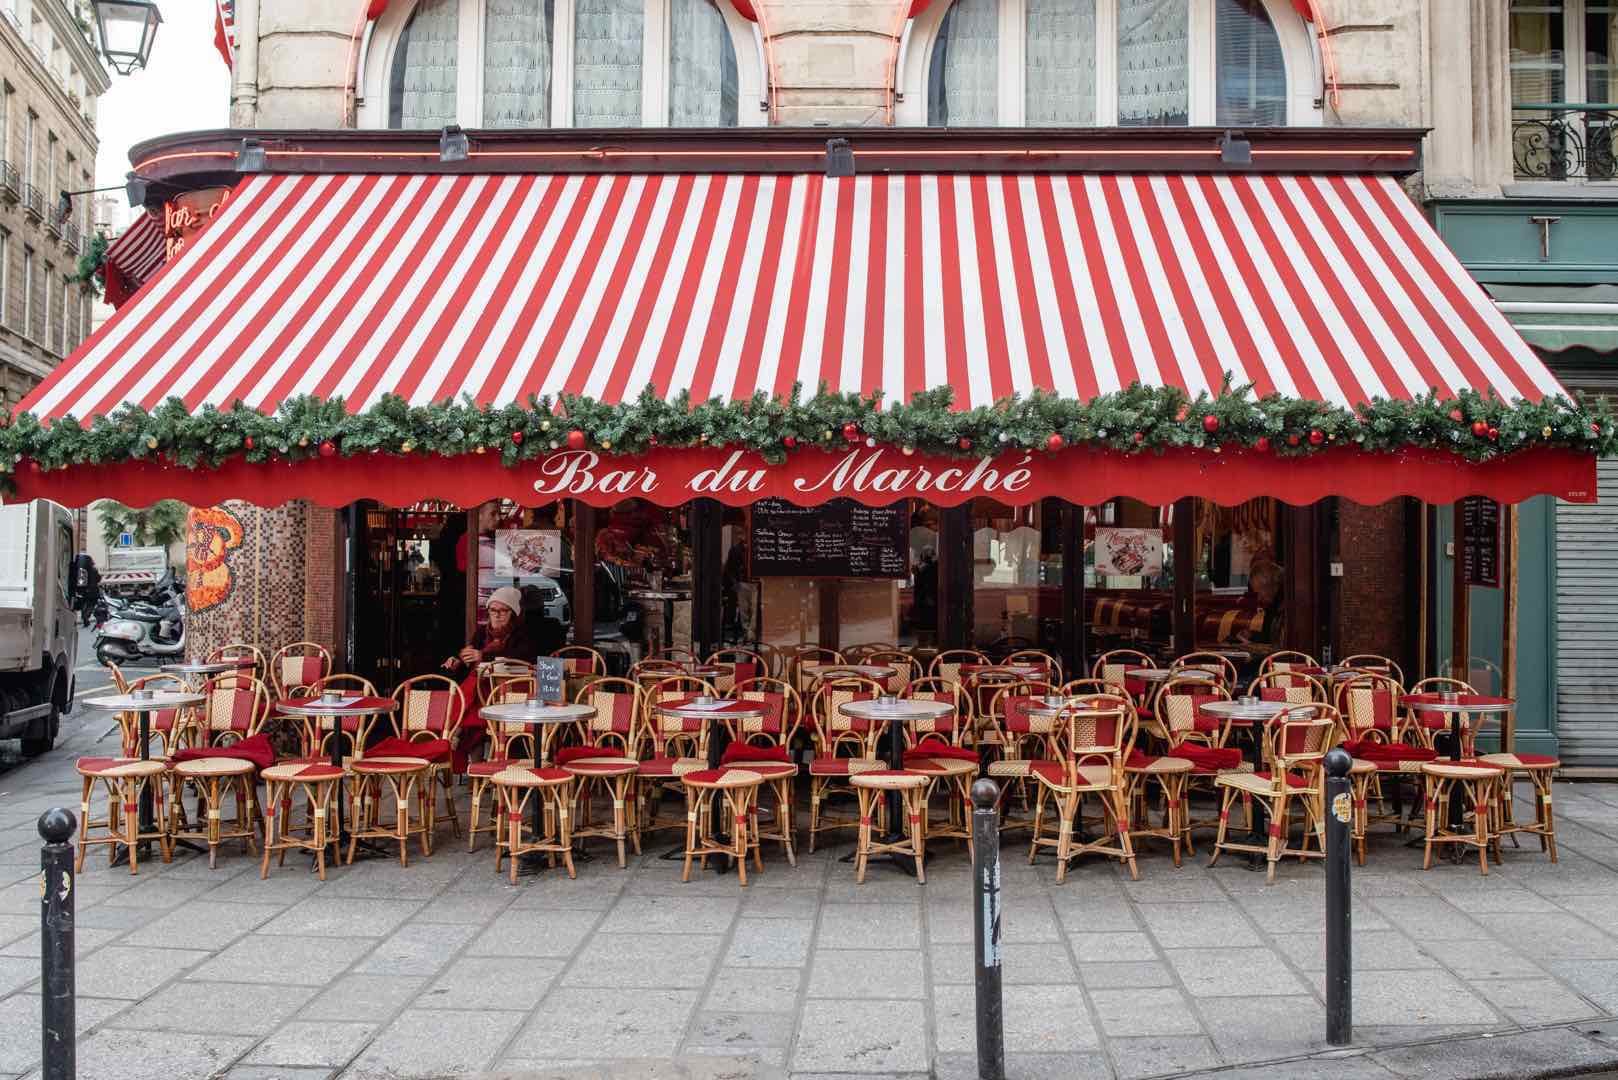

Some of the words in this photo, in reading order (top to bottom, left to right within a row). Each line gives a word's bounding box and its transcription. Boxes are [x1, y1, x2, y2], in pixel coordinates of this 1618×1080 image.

[533, 450, 660, 494] Bar
[684, 450, 767, 492] du
[793, 448, 1034, 492] Marché
